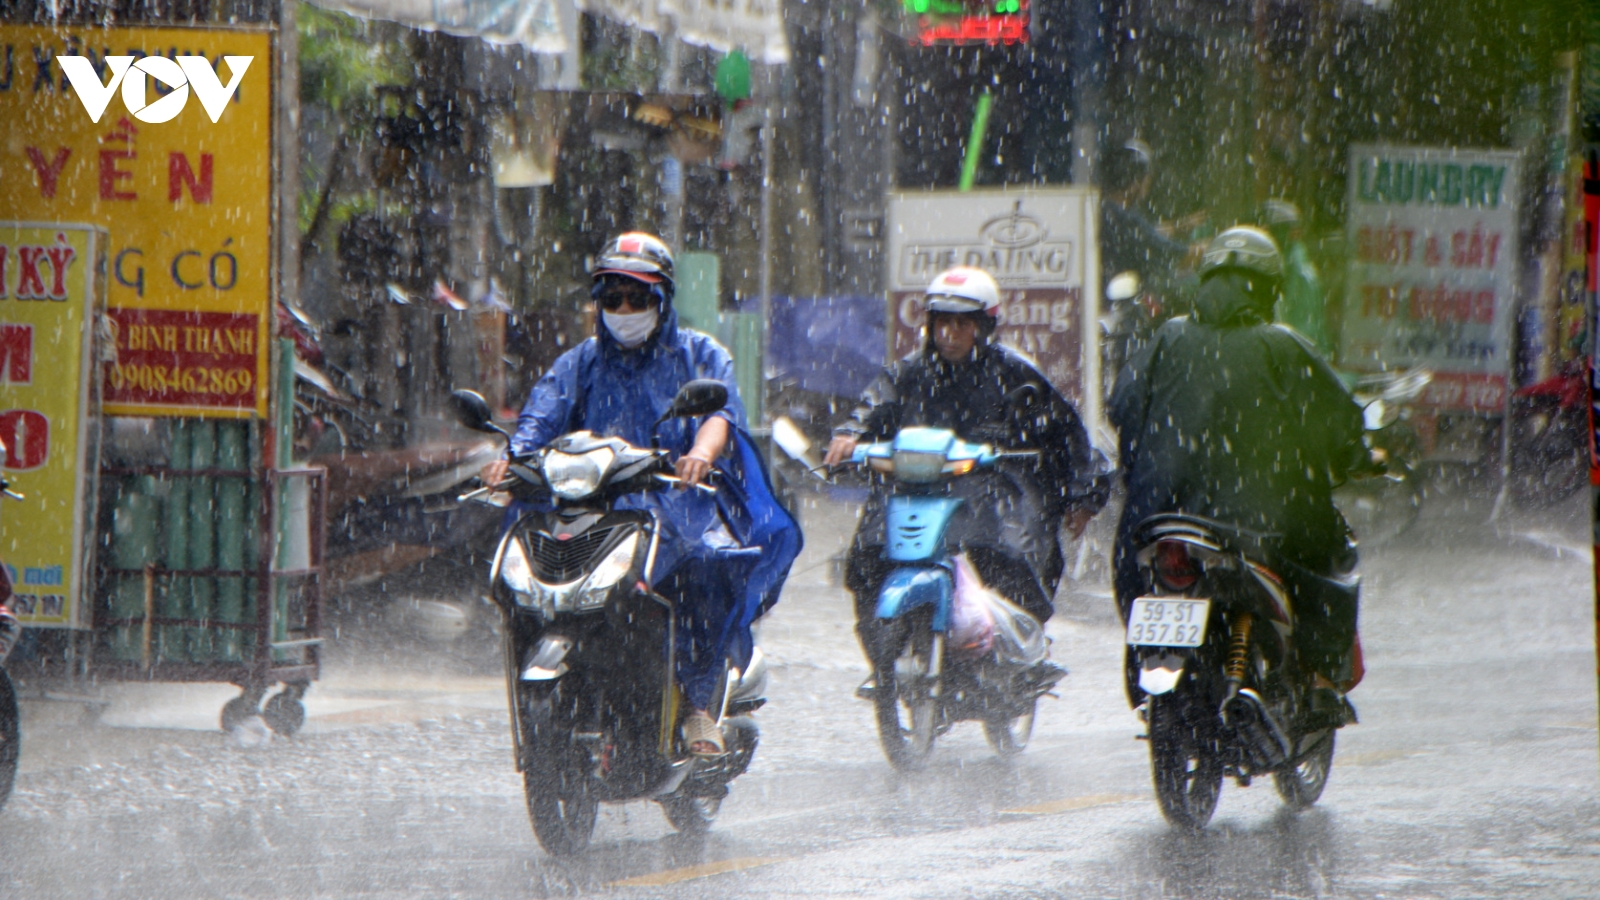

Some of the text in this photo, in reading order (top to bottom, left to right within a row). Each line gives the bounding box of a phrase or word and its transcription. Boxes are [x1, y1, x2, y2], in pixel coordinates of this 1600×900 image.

[1356, 157, 1507, 210] LAUNDRY
[171, 236, 238, 291] CÓ
[963, 249, 1066, 274] DATING
[128, 318, 178, 352] BÌNH
[109, 363, 252, 396] 0908462869
[1142, 602, 1196, 623] 59-S1
[1131, 623, 1201, 644] 357.62
